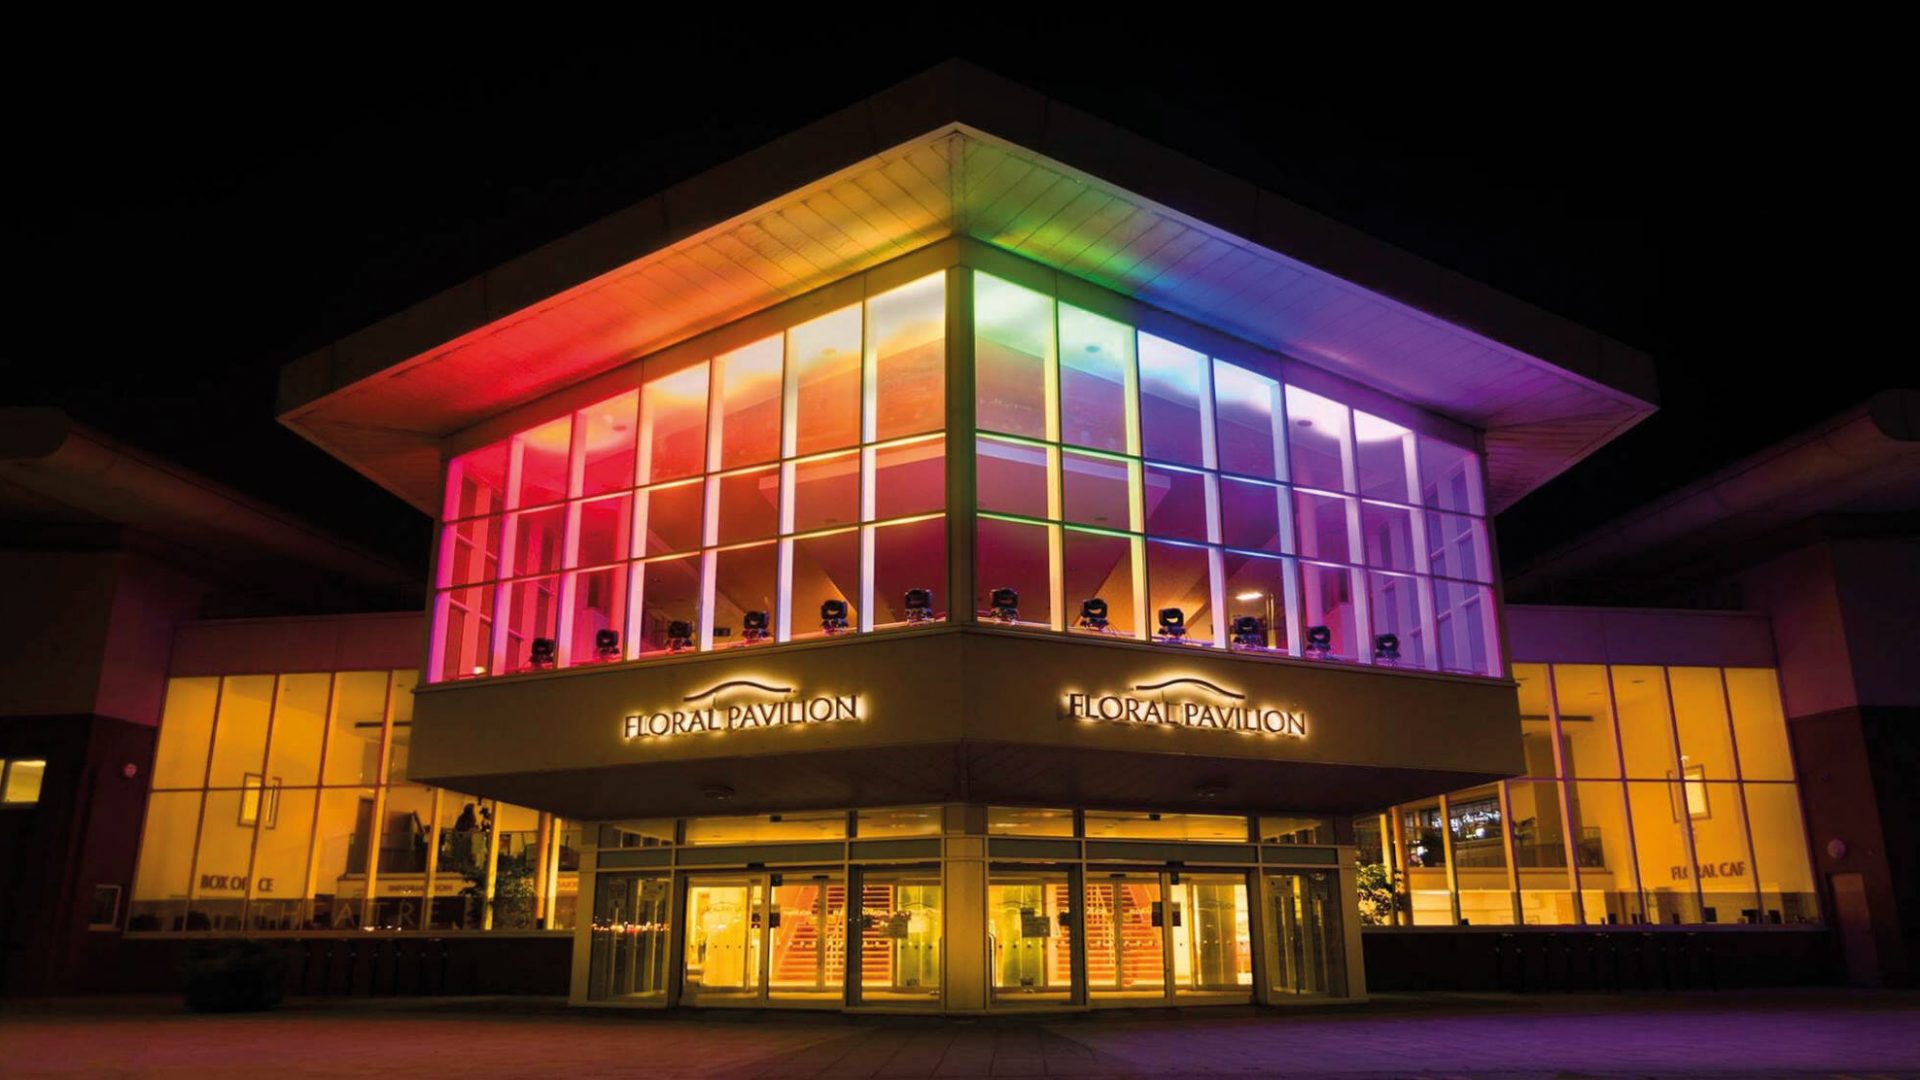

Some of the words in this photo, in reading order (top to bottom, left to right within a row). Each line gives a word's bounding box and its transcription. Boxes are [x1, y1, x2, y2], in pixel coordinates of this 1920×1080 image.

[624, 708, 721, 738] FLORAL
[727, 694, 858, 728] PAVILION
[1068, 693, 1177, 724] FLORAL
[1184, 702, 1306, 735] PAVILION
[201, 874, 229, 890] BOX
[230, 876, 274, 892] OFCE
[1670, 863, 1718, 880] FLAL
[1719, 861, 1746, 877] CAF
